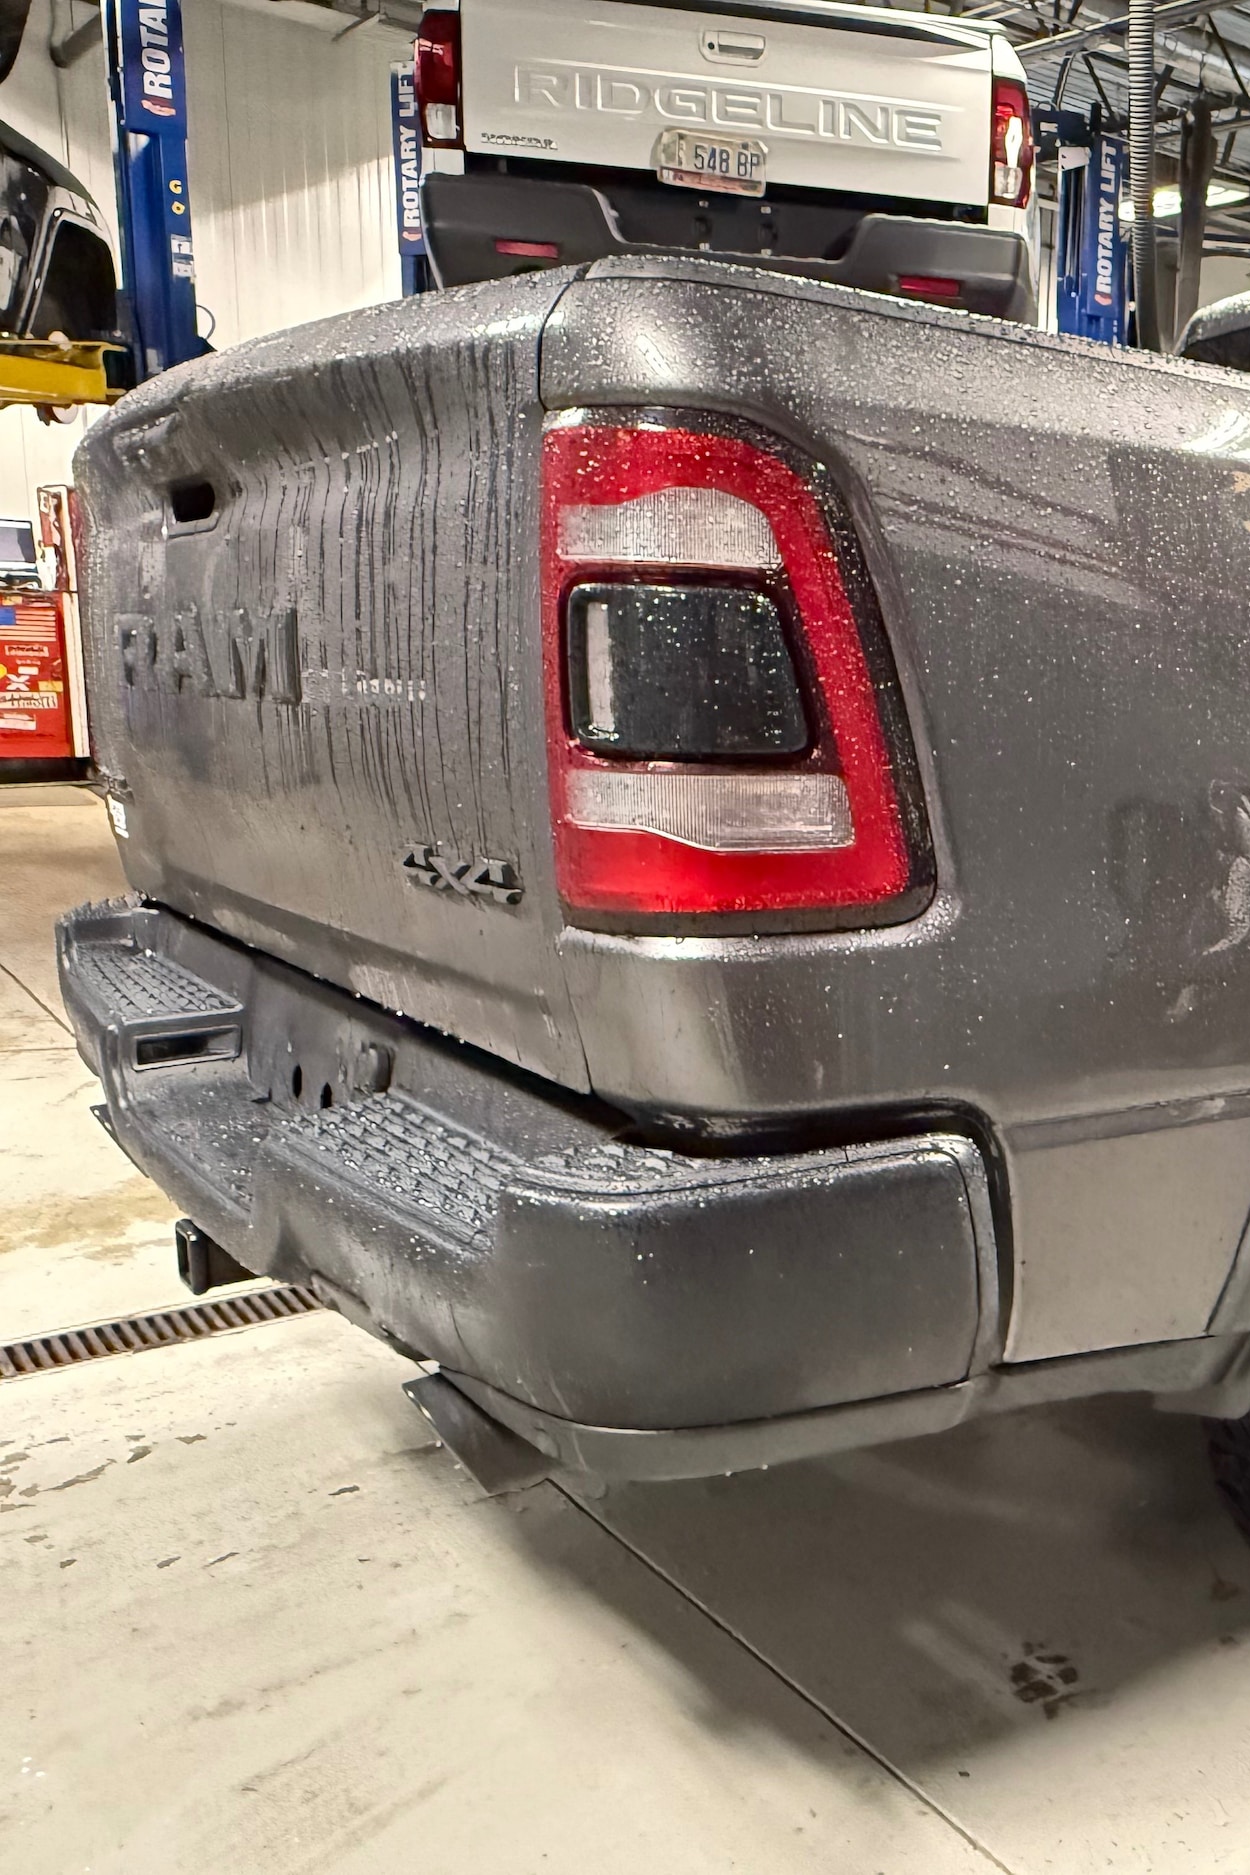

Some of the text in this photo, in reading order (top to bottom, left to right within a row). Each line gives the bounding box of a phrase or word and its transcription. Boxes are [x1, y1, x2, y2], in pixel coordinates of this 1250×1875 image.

[138, 0, 173, 99] ROTA
[513, 64, 943, 152] RIDGELINE
[401, 125, 420, 227] ROTARY
[694, 143, 731, 175] 548
[1096, 140, 1116, 294] ROTARY LIFT
